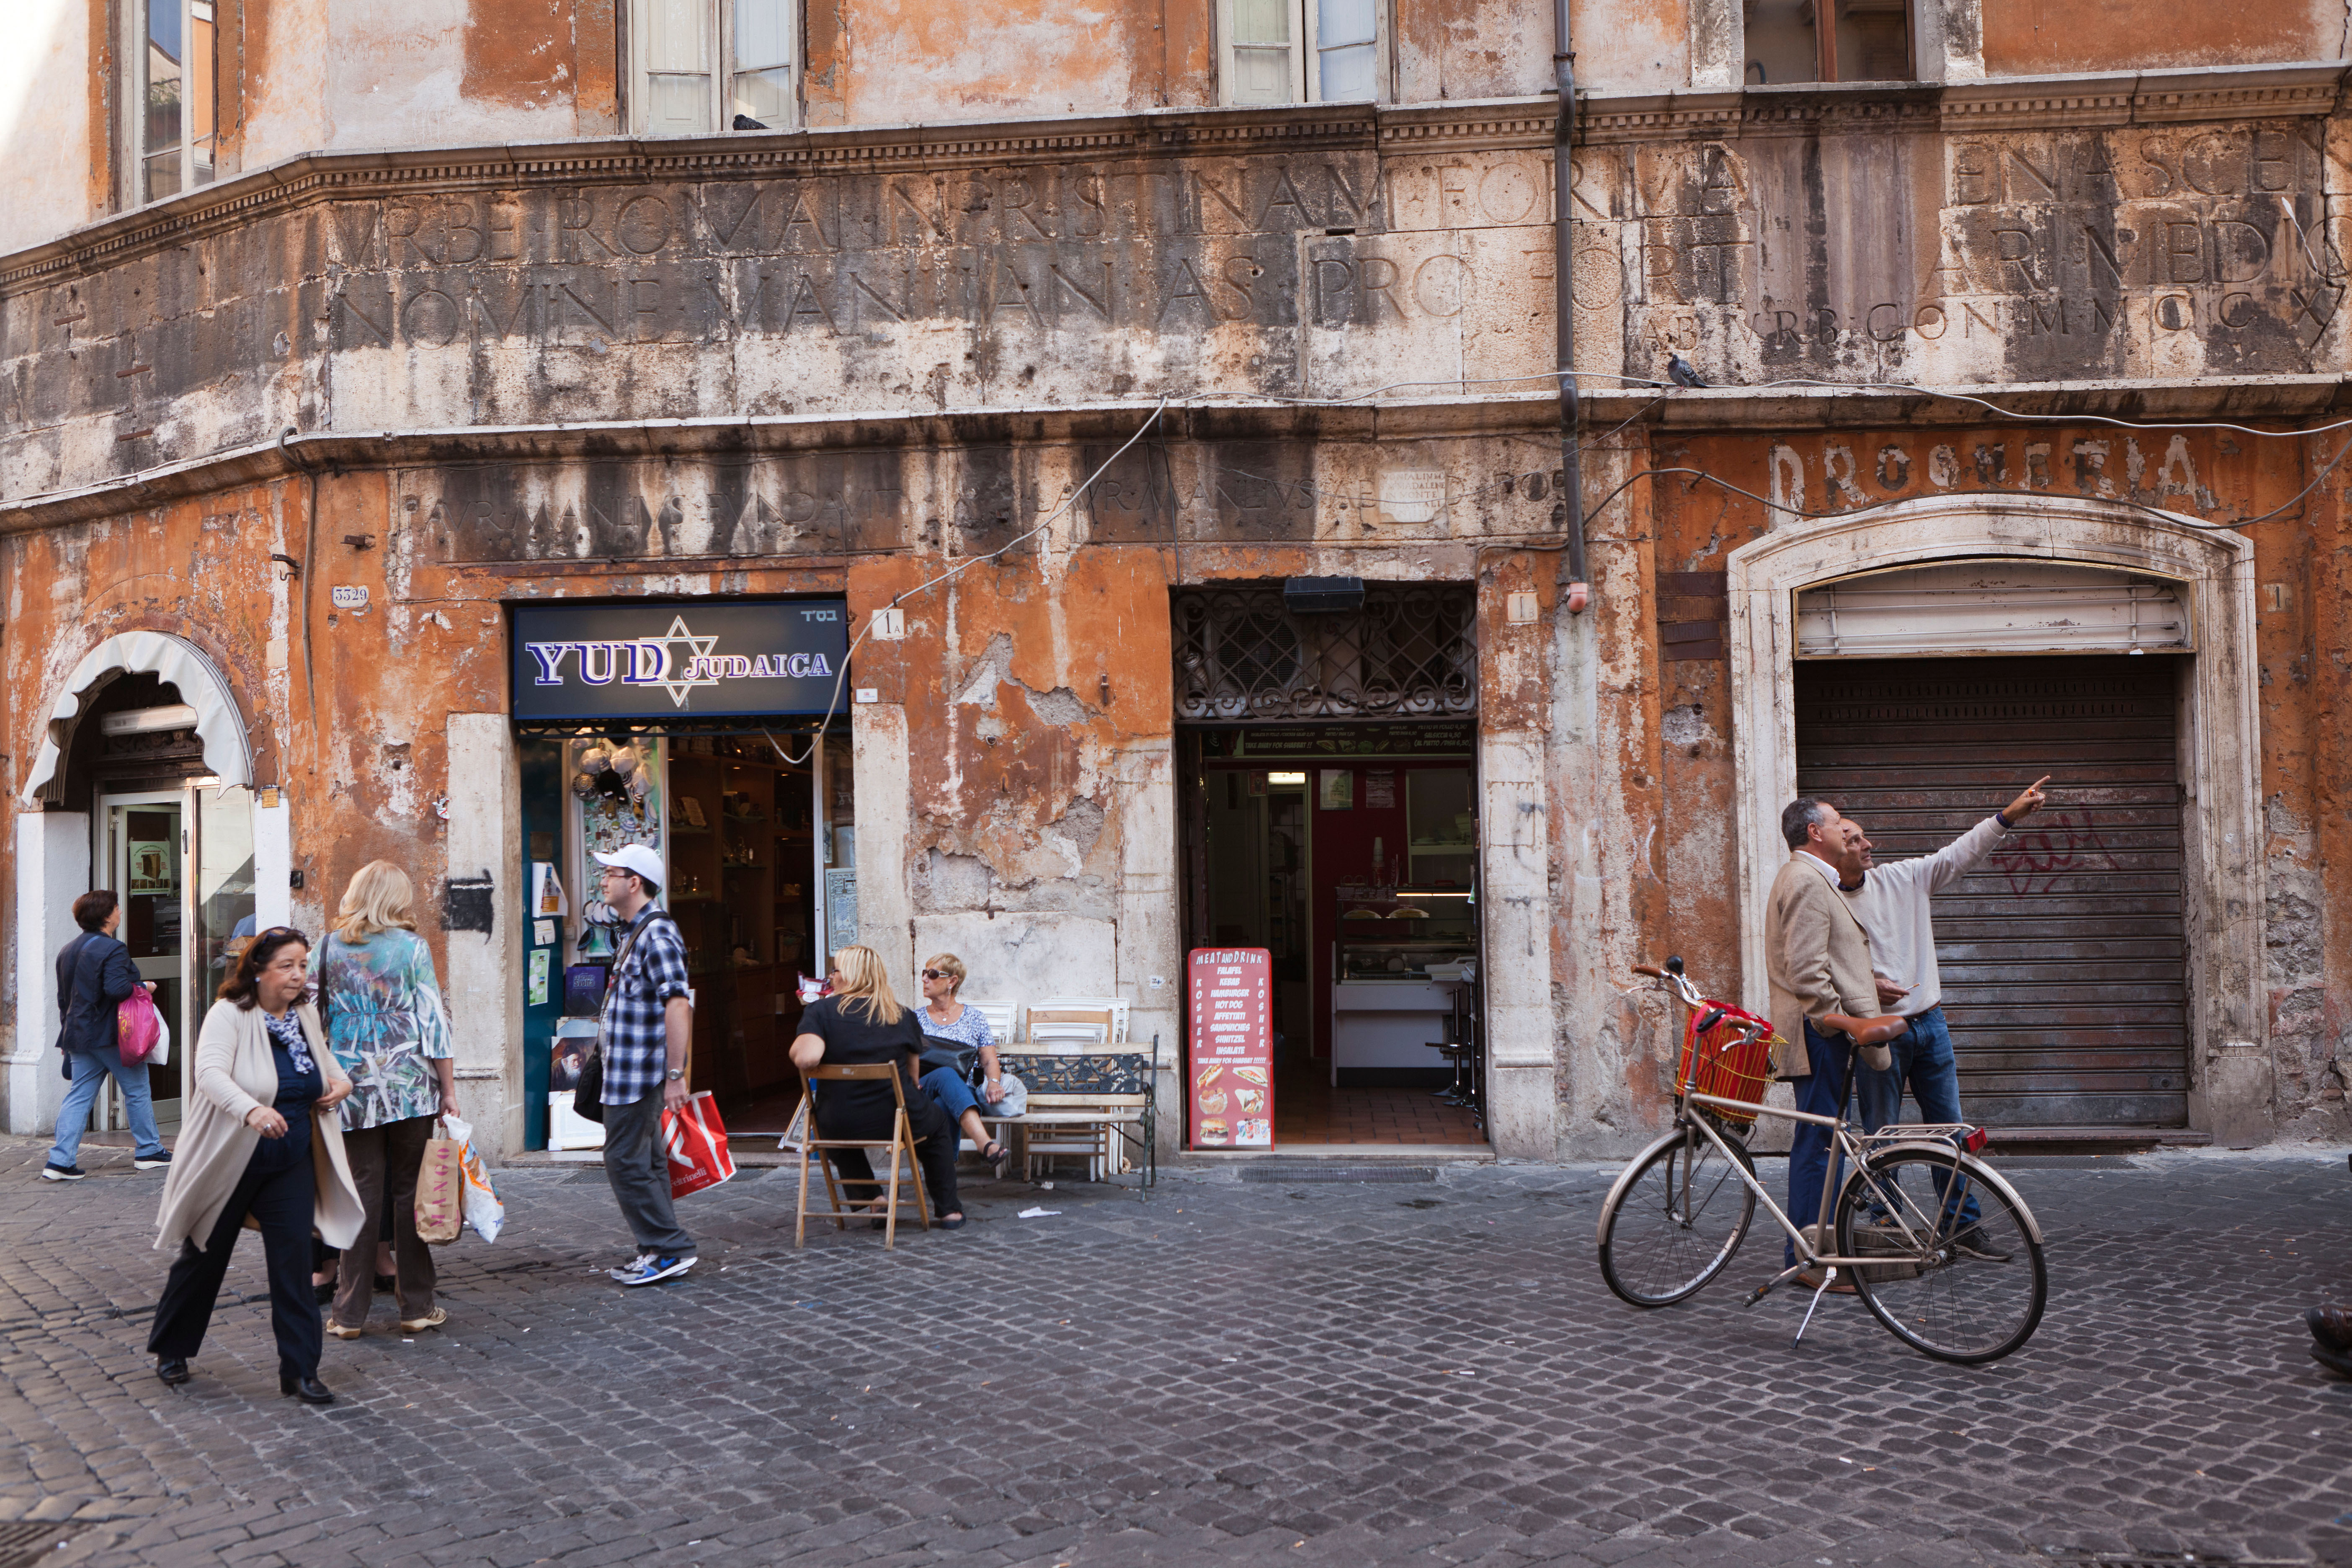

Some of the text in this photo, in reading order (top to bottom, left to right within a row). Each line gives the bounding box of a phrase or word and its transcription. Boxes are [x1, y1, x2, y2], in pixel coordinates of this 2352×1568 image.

[557, 178, 840, 262] ROMA
[335, 277, 663, 351] NOMINE
[1308, 253, 1478, 323] PRO
[1769, 434, 2217, 529] DROGHERIA
[335, 589, 367, 601] 3329
[526, 640, 833, 686] YUD JUDAICA
[1196, 951, 1262, 965] MEAT AND DRINK
[1217, 967, 1242, 975] FALAFEL
[1219, 977, 1240, 986] KEBAB
[1210, 989, 1250, 998] HAMBURGER
[1215, 1000, 1243, 1009] HOT DOG
[1214, 1012, 1246, 1020] AFFETTATI
[1210, 1023, 1251, 1032] SANDWICHES
[1215, 1034, 1246, 1043] SHNITZEL
[1216, 1046, 1246, 1055] INSALATE
[430, 1148, 450, 1227] MANGO
